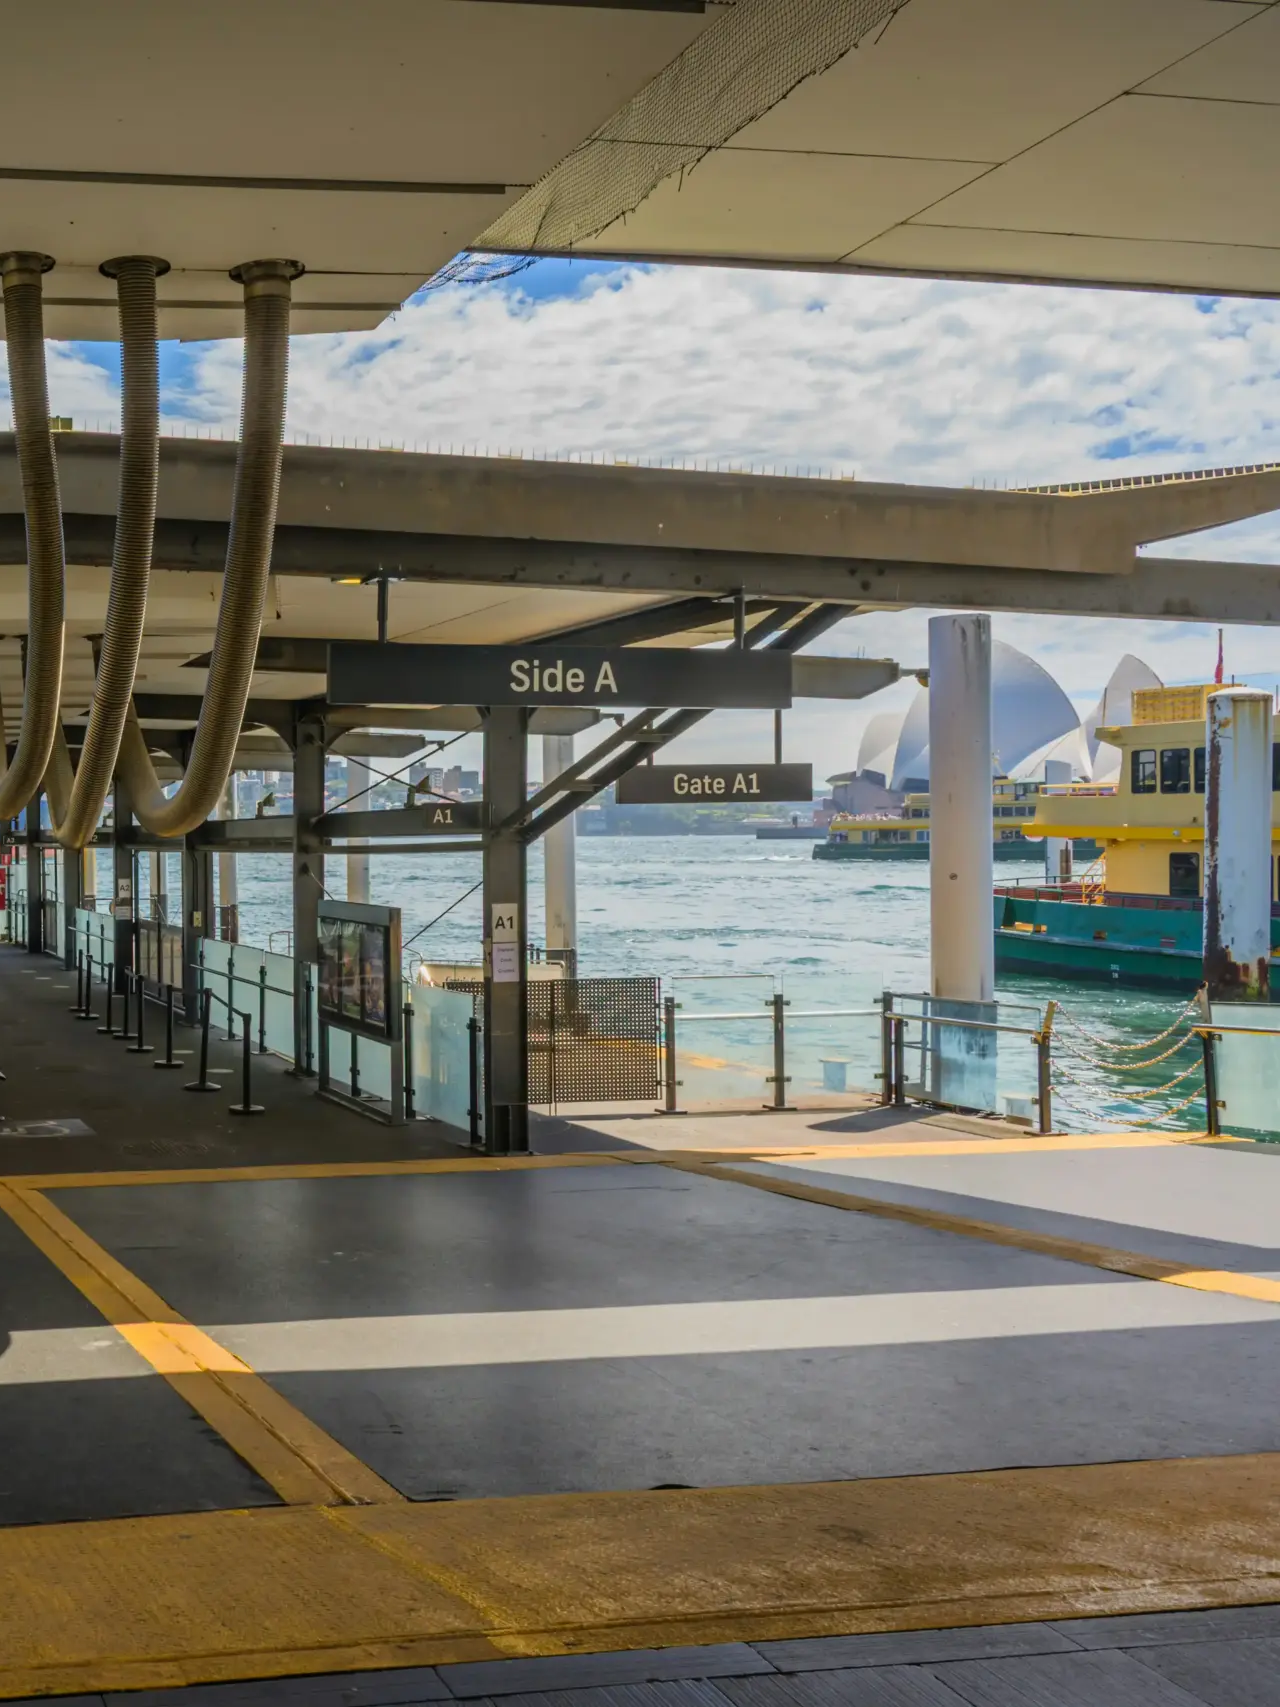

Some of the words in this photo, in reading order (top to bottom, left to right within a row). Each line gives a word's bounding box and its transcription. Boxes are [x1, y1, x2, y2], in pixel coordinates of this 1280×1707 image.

[509, 659, 585, 693] Side
[594, 661, 618, 694] A
[673, 773, 726, 795] Gate
[732, 772, 761, 795] A1
[433, 808, 453, 824] A1
[119, 884, 130, 892] A2
[494, 915, 514, 929] A1
